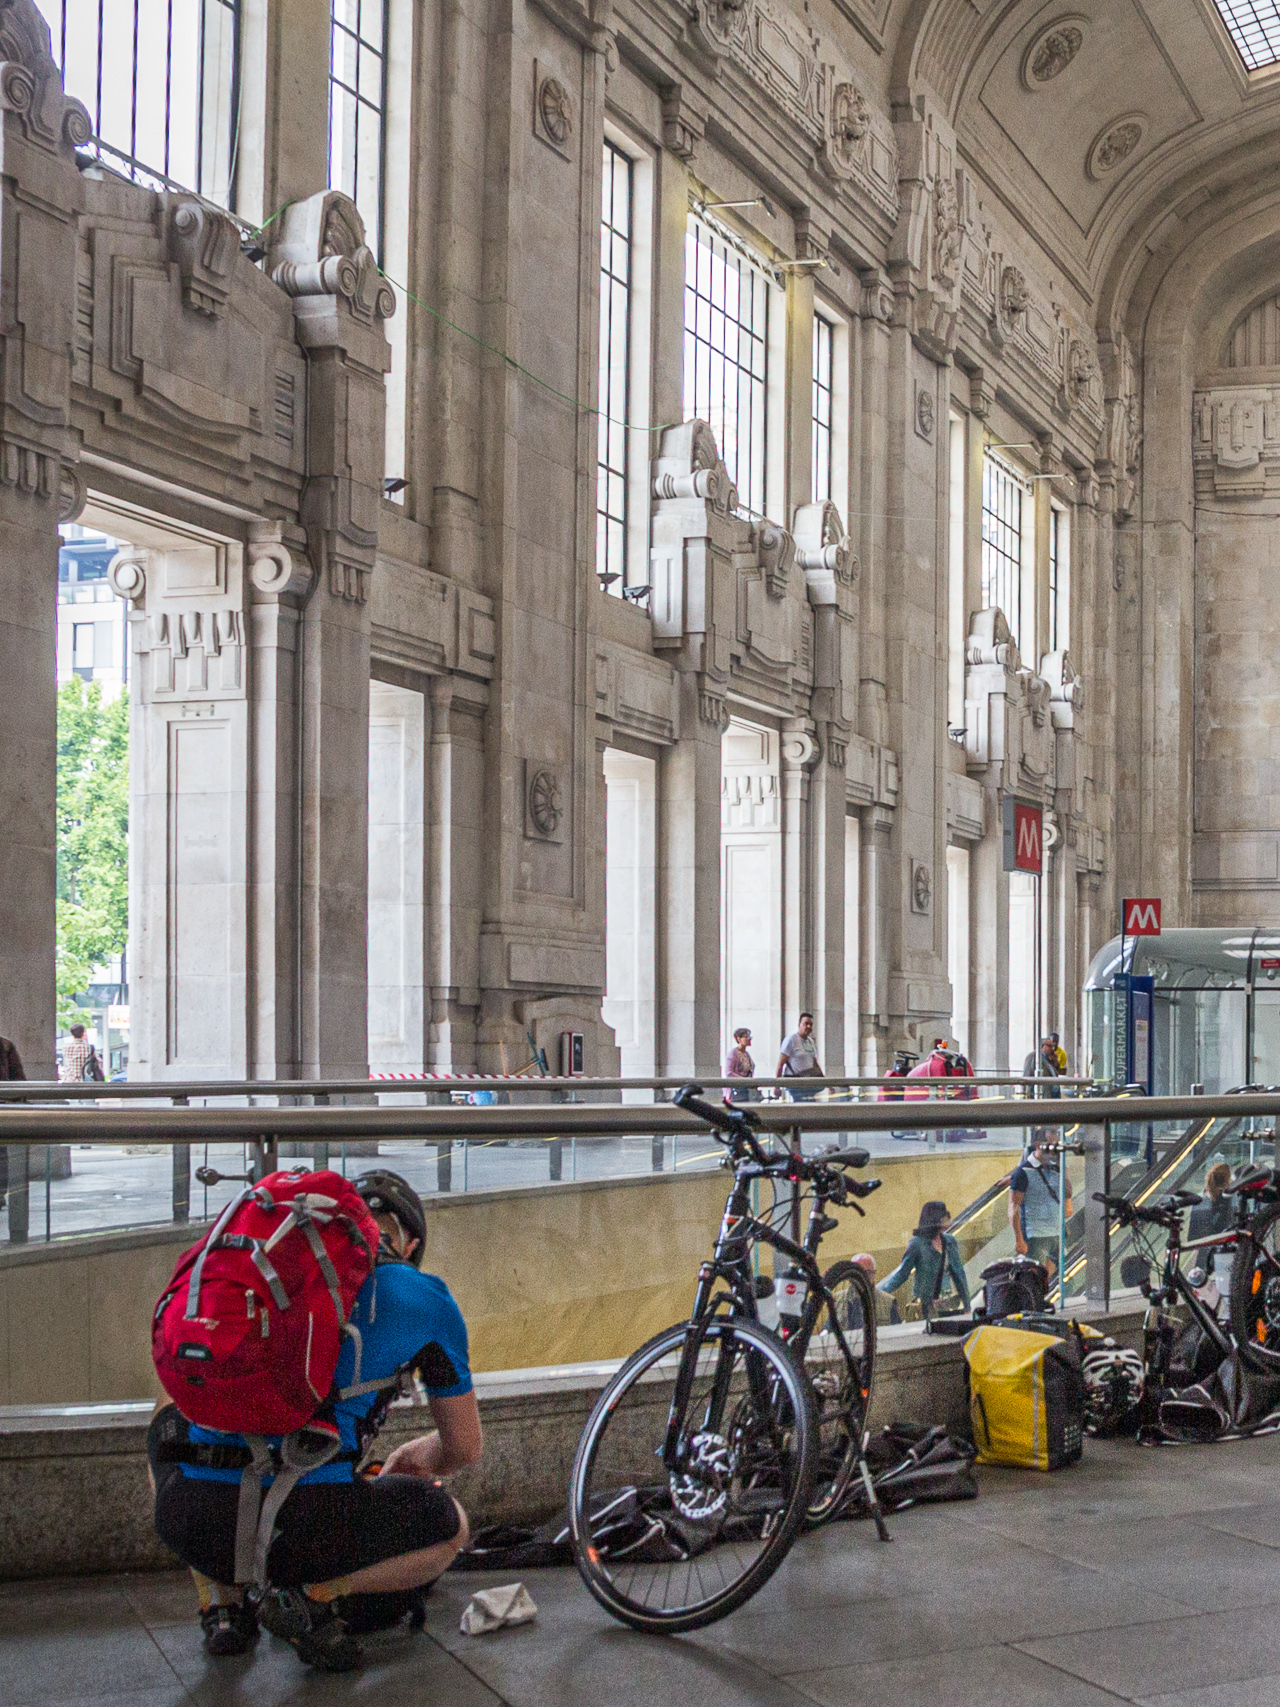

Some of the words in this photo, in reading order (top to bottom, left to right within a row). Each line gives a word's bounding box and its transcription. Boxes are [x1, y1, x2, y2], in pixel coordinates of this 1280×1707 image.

[1018, 817, 1040, 860] M
[1127, 904, 1159, 929] M
[1116, 997, 1127, 1081] SUPERMARKET
